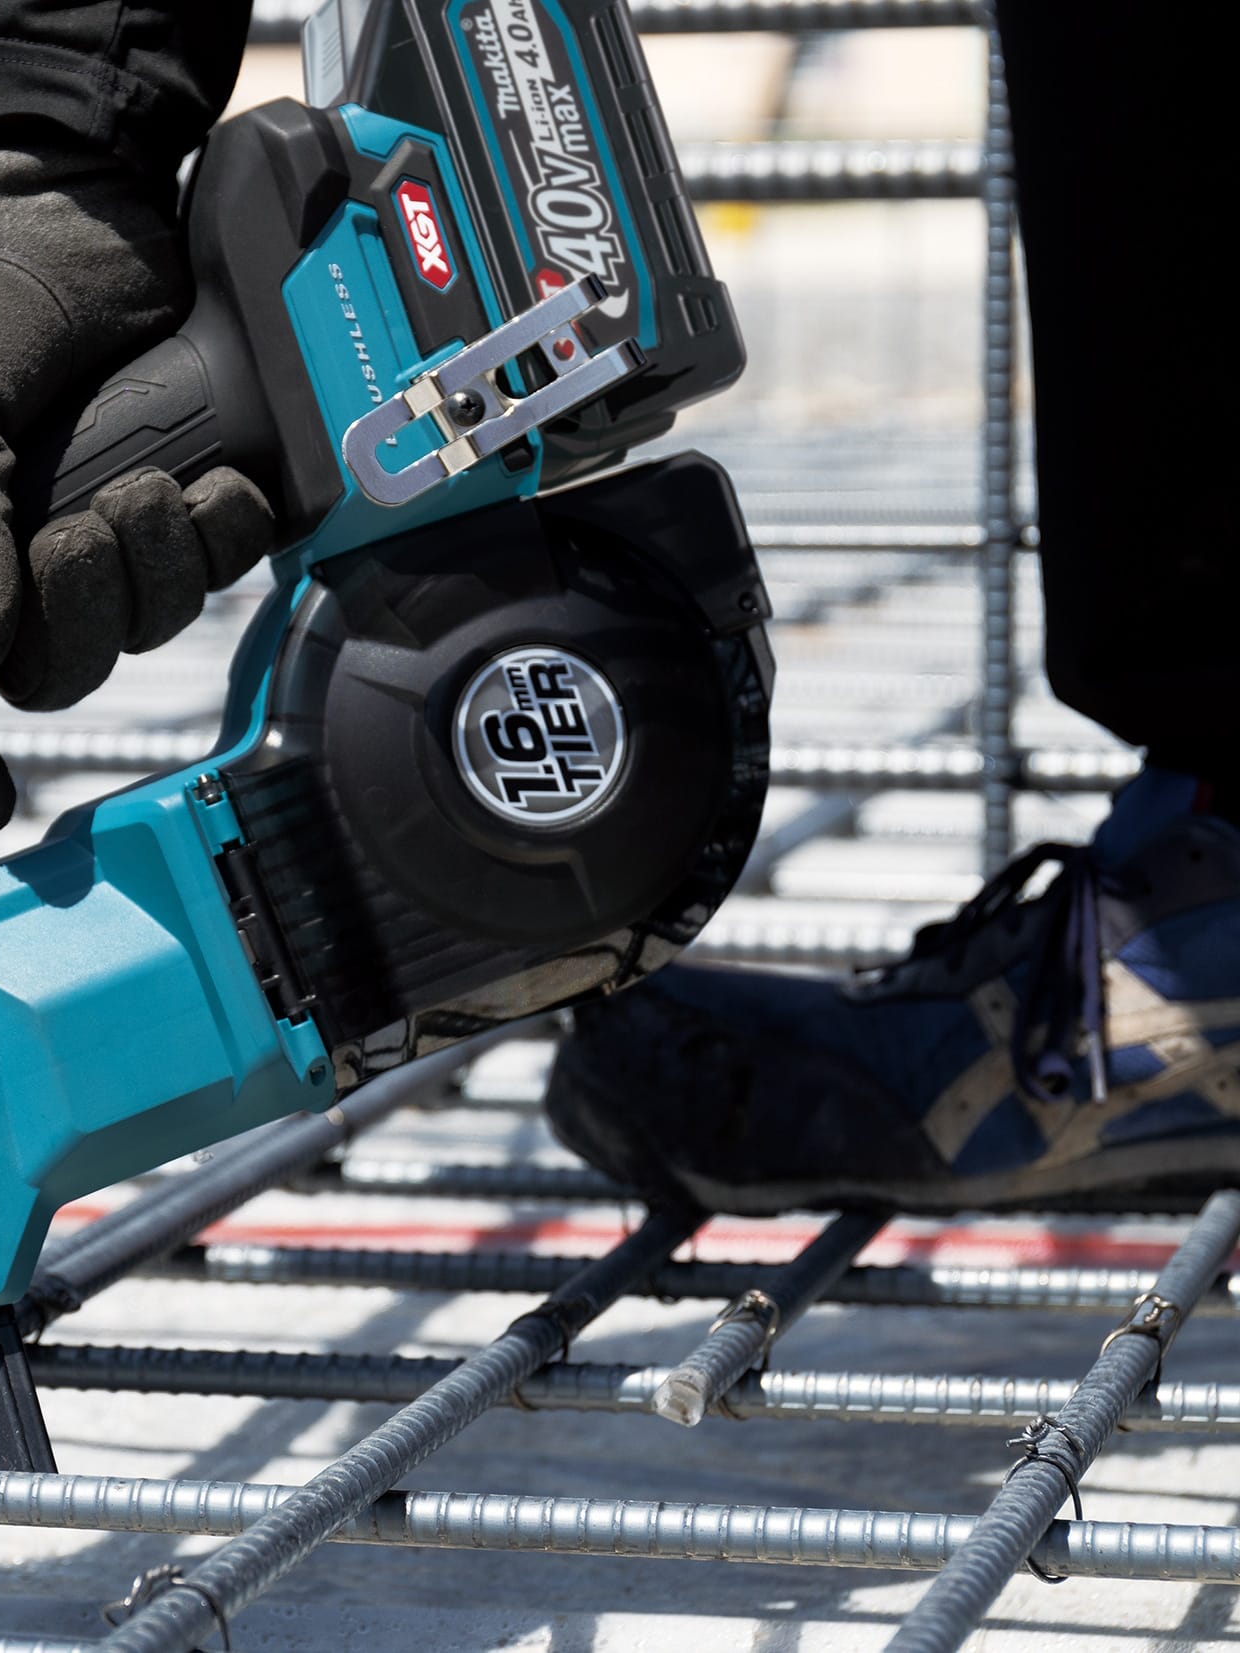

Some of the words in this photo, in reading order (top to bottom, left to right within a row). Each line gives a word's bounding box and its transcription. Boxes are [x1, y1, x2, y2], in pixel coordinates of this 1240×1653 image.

[401, 193, 449, 273] XGT
[328, 263, 397, 446] USHLESS
[528, 662, 603, 793] TIER
